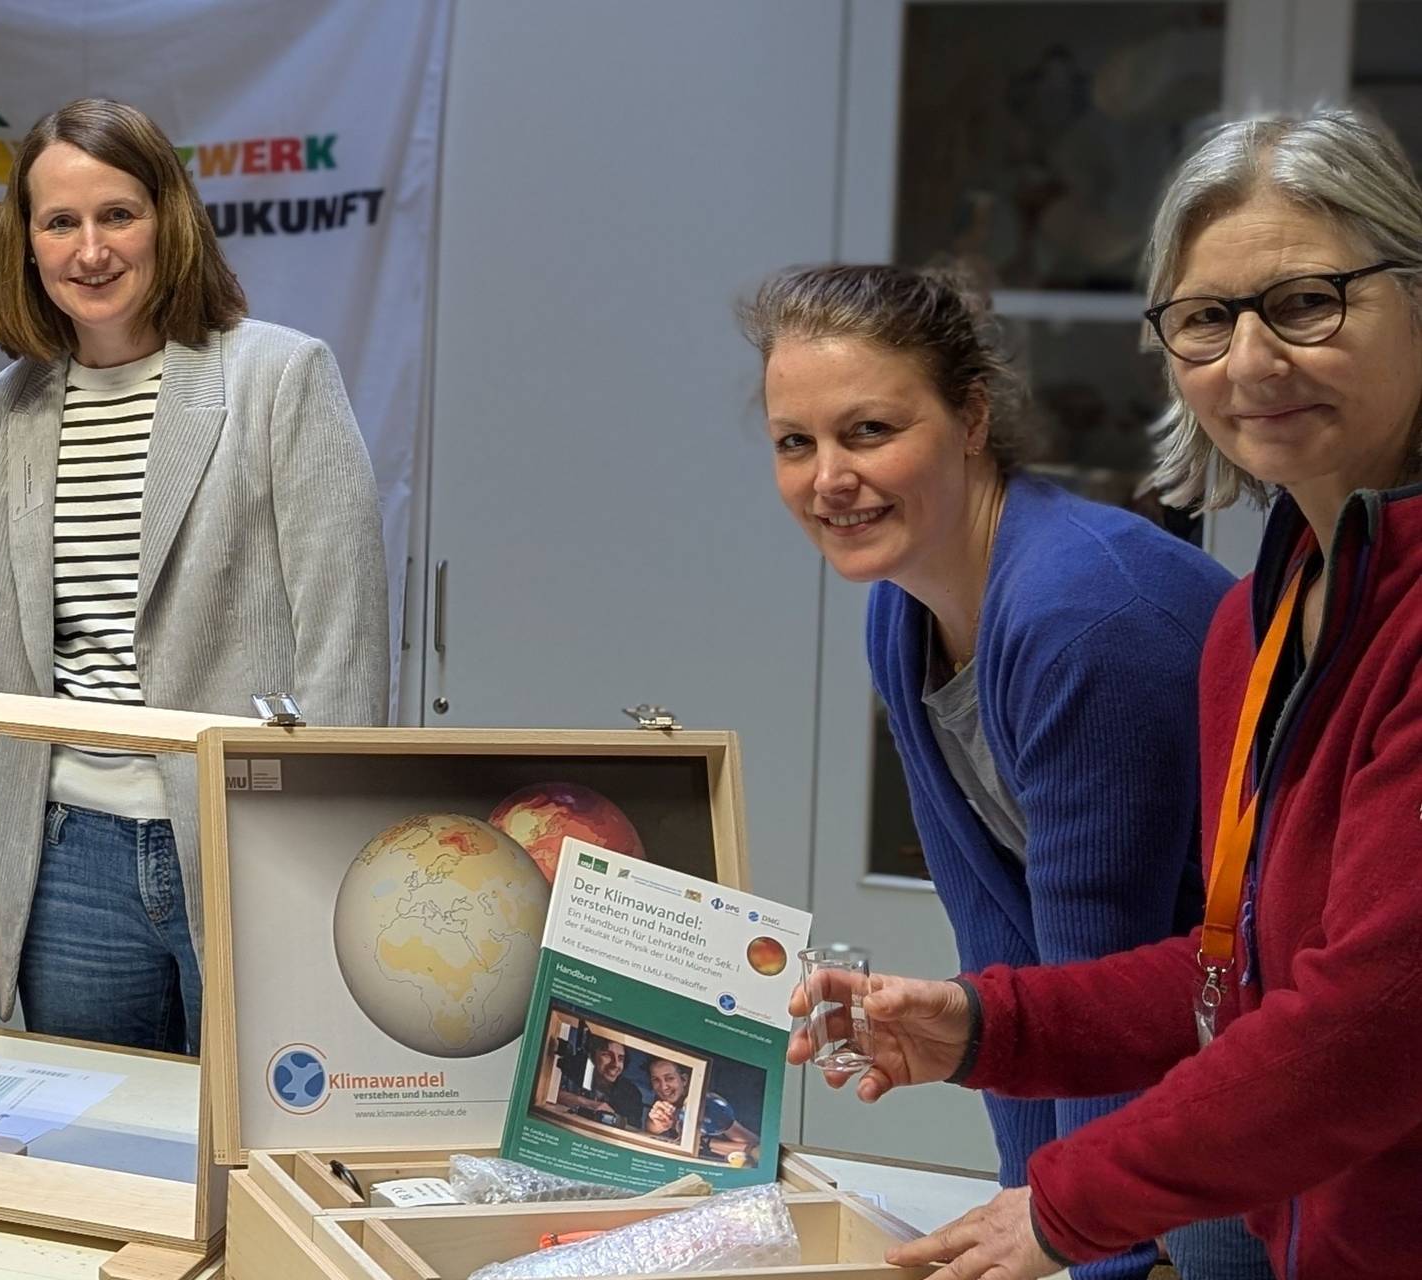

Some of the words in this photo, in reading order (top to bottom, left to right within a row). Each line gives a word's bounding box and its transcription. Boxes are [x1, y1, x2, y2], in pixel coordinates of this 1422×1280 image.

[204, 187, 385, 238] UKUNFT
[226, 776, 247, 789] MU
[573, 876, 600, 895] Der
[604, 887, 703, 930] Klimawandel:
[725, 904, 740, 913] DPG
[570, 894, 629, 921] verstehen
[632, 915, 656, 930] und
[658, 922, 707, 947] handeln
[564, 919, 579, 929] der
[624, 940, 648, 953] Physik
[650, 948, 664, 959] der
[685, 959, 723, 979] München
[567, 907, 582, 919] Ein
[583, 913, 630, 935] Handbuch
[632, 929, 646, 941] für
[648, 935, 695, 958] Lehrkräfte
[697, 952, 714, 964] der
[714, 957, 734, 970] Sek.
[556, 962, 597, 985] Handbuch
[328, 1072, 445, 1089] Klimawandel
[353, 1090, 399, 1099] verstehen
[401, 1090, 419, 1099] und
[421, 1089, 459, 1098] handeln
[354, 1108, 467, 1118] www.klimawandel-schule.de
